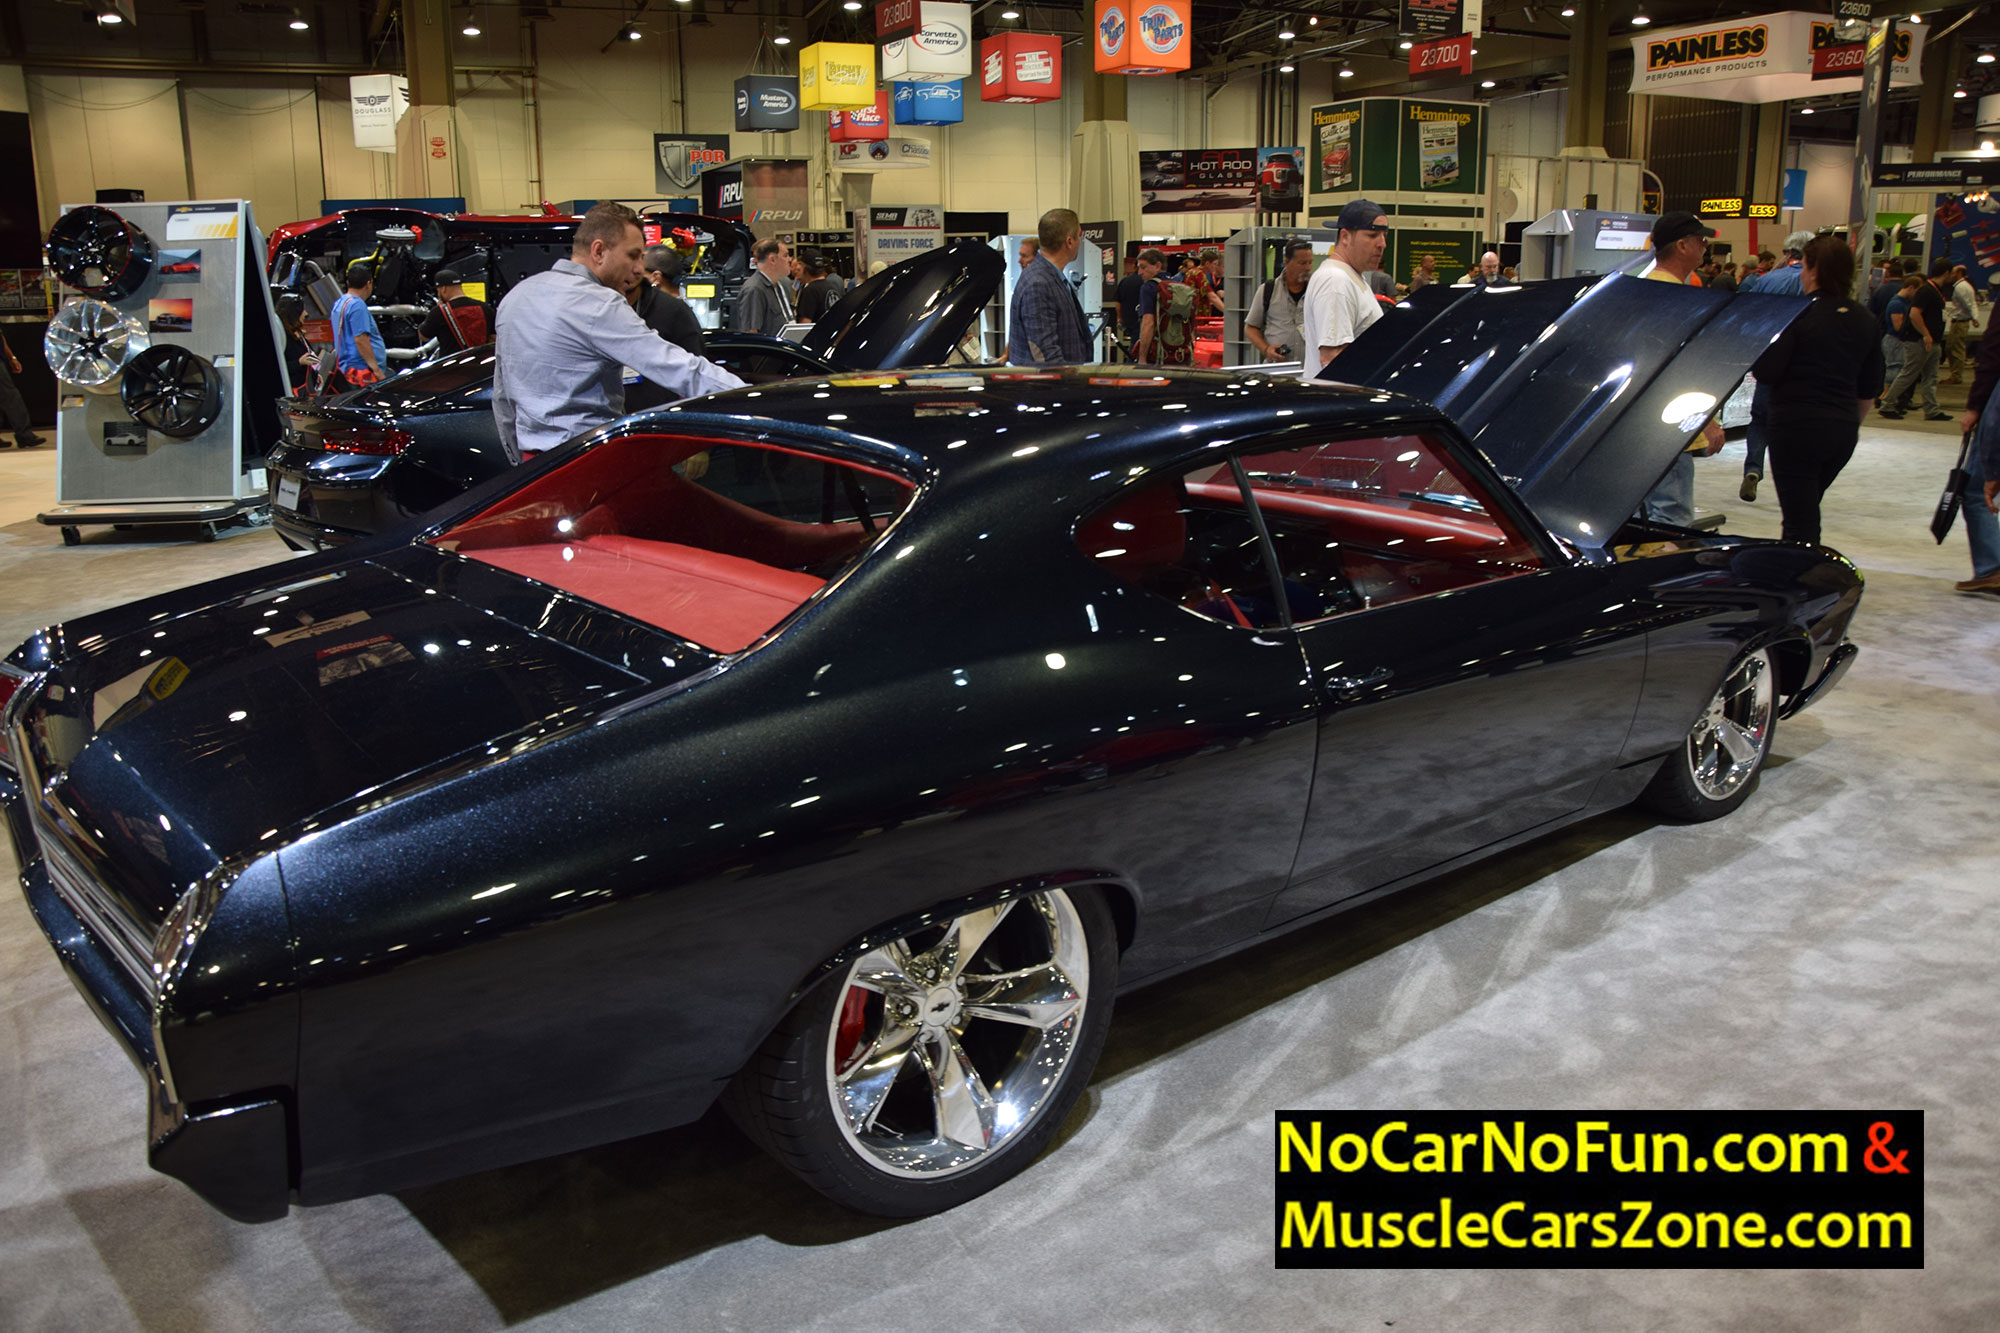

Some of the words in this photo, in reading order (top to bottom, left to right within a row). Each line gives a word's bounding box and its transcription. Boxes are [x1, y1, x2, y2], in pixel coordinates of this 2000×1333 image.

[883, 0, 912, 27] 23800
[1840, 1, 1871, 16] 23600
[1140, 14, 1166, 32] TRIM
[920, 30, 957, 38] Corvette
[1154, 23, 1183, 44] PARTS
[923, 38, 959, 46] America
[1649, 27, 1766, 69] PAINLESS
[1420, 44, 1460, 67] 23700
[1825, 49, 1867, 68] 2360
[1645, 67, 1711, 82] PERFORMANCE
[1715, 60, 1767, 72] PRODUCTS
[760, 94, 788, 102] Mustang
[856, 112, 880, 122] Place
[1313, 107, 1361, 126] Hemmings
[1409, 105, 1471, 126] Hemmings
[690, 149, 725, 163] POR
[1190, 162, 1219, 171] HOT
[1222, 160, 1252, 170] ROD
[1702, 199, 1741, 211] PAINLESS
[758, 209, 803, 221] RPUI
[1085, 229, 1104, 240] RPUI
[878, 238, 908, 249] DRIVING
[910, 238, 934, 249] FORCE
